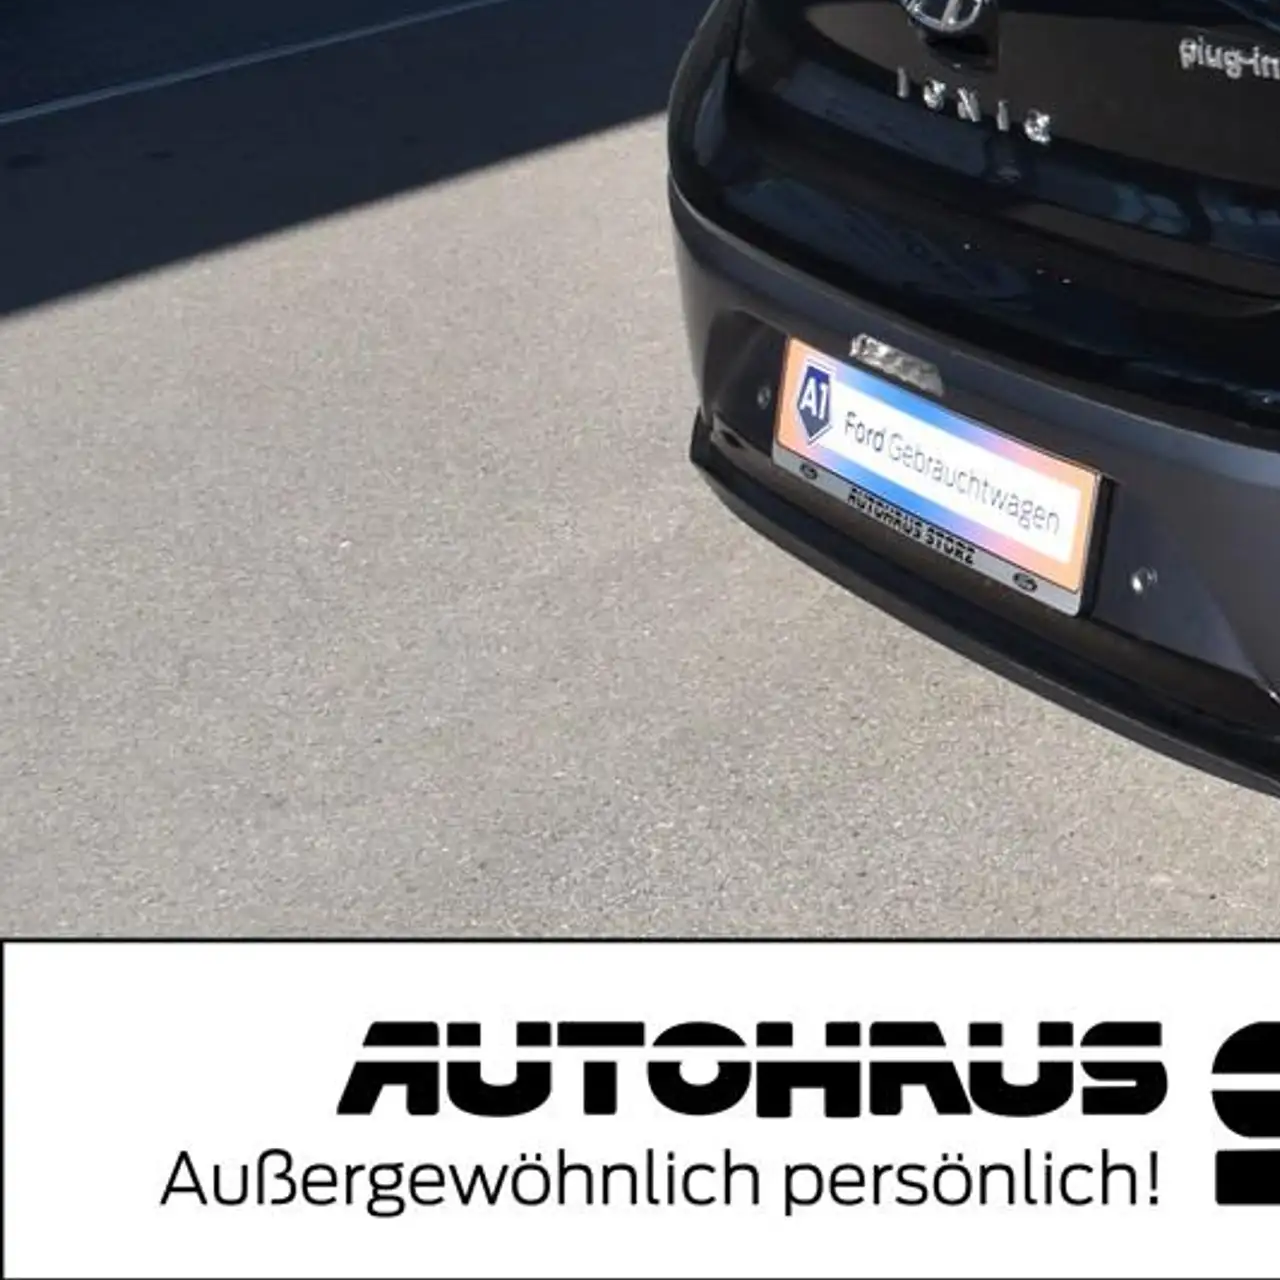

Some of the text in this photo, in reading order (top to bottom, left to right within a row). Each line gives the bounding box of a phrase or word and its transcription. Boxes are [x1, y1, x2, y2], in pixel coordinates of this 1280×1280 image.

[1179, 35, 1280, 80] plug-in
[844, 410, 1060, 534] Ford Gebrauchtwagen
[848, 487, 976, 565] AUTOHAUS STORZ
